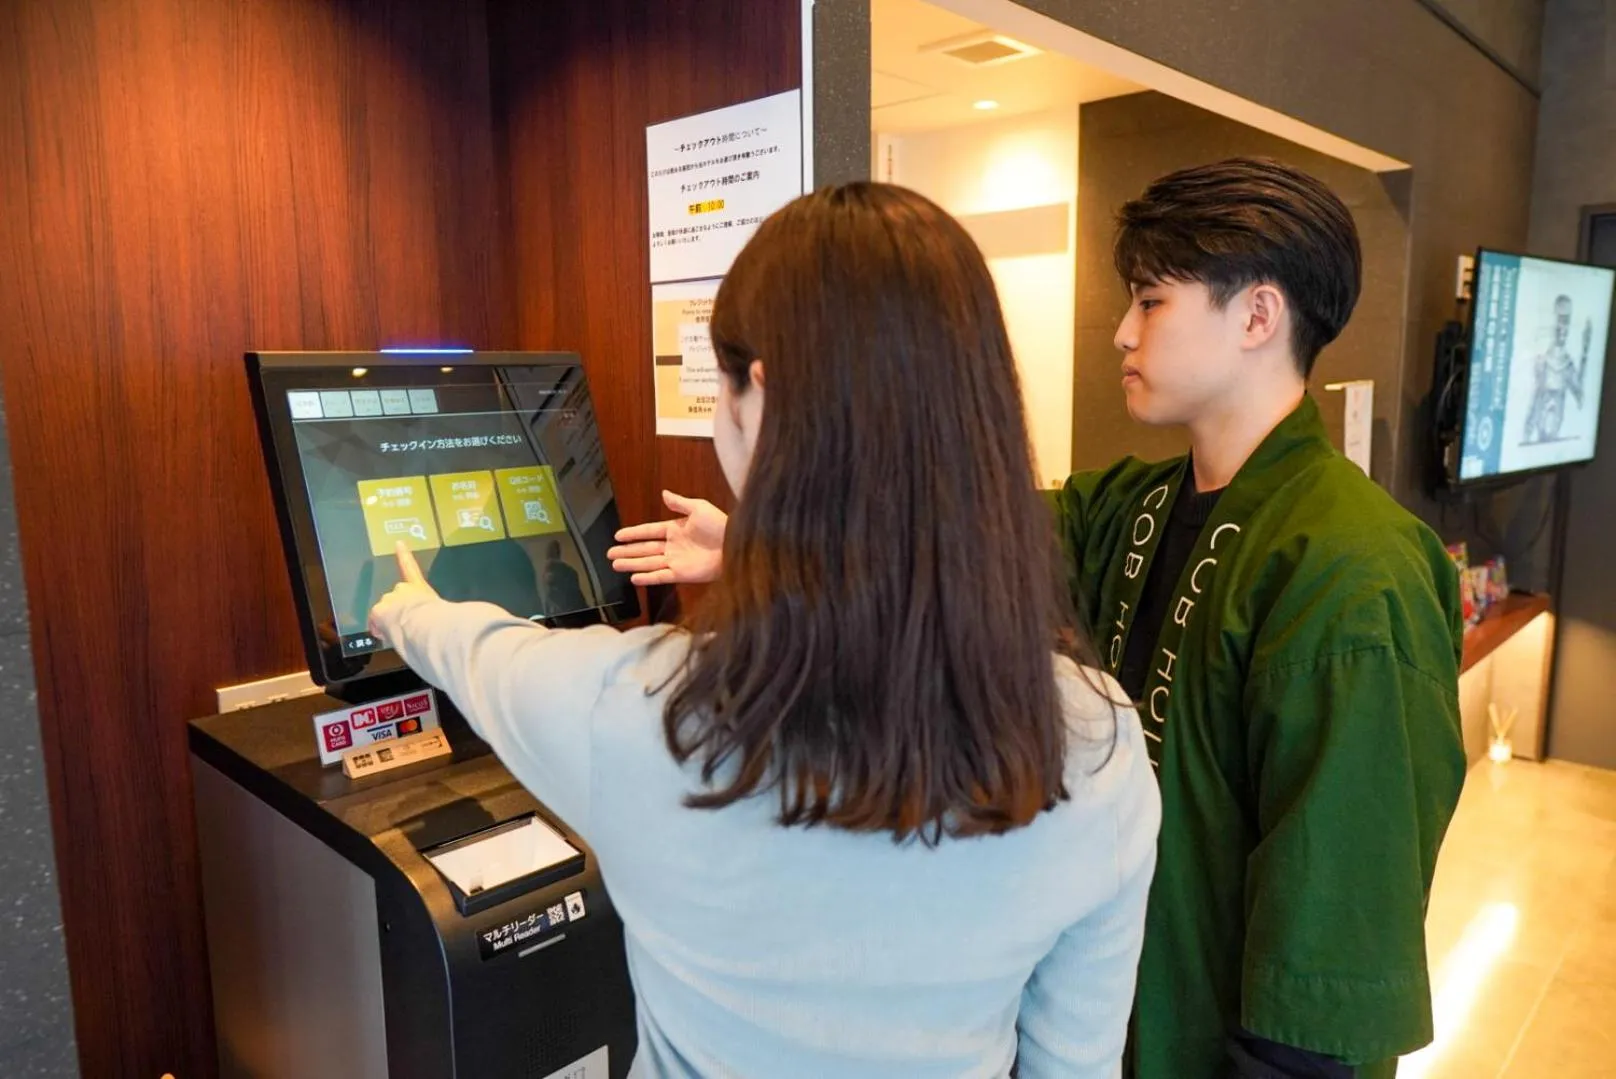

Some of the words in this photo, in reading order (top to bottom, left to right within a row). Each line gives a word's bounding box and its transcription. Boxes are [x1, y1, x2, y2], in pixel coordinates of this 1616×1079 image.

[681, 170, 760, 193] チェックアウト時間のご案内
[380, 434, 522, 452] チェックイン方法をお選びください
[1124, 484, 1169, 579] COB
[371, 729, 393, 741] VISA
[483, 913, 544, 942] マルチリーダー
[493, 936, 514, 951] Multi
[514, 925, 541, 942] Reader
